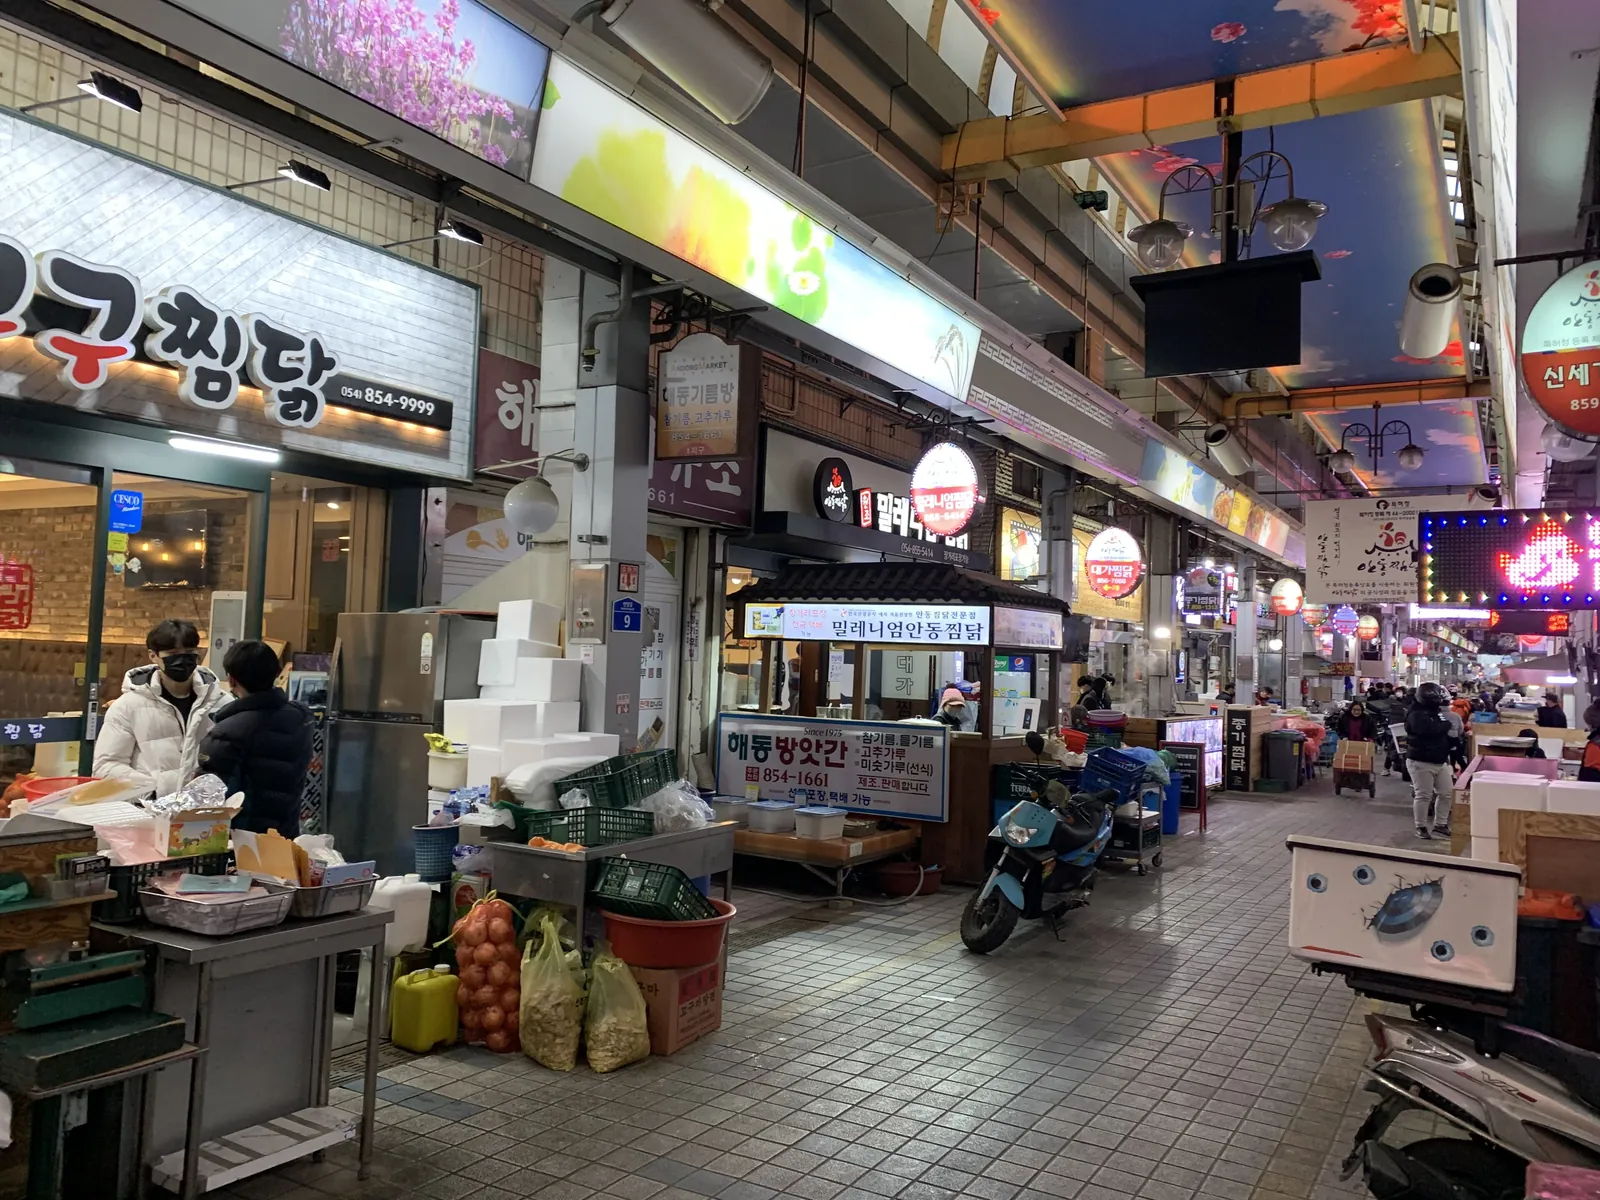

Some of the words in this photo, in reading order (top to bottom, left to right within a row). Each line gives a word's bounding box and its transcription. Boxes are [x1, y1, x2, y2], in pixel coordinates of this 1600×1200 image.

[1543, 362, 1600, 390] 신세
[340, 384, 362, 400] (054)
[364, 387, 436, 416] 854-9999
[113, 494, 140, 506] CESCO
[1091, 564, 1134, 578] 대가찜닭
[623, 614, 631, 629] 9
[915, 610, 977, 620] 안동찜닭전문점
[832, 620, 985, 642] 밀레니엄안동찜닭
[825, 728, 843, 738] 1975
[862, 731, 934, 748] 참기름.들기름
[727, 731, 848, 769] 해동방앗간
[860, 746, 906, 761] 고추가루
[1231, 718, 1247, 772] 종가찜닭
[860, 760, 934, 777] 미숫가루(선식)
[763, 768, 829, 787] 854-1661
[1010, 782, 1032, 793] TERRA
[788, 787, 848, 804] 선포장.택배
[851, 793, 871, 806] 가능
